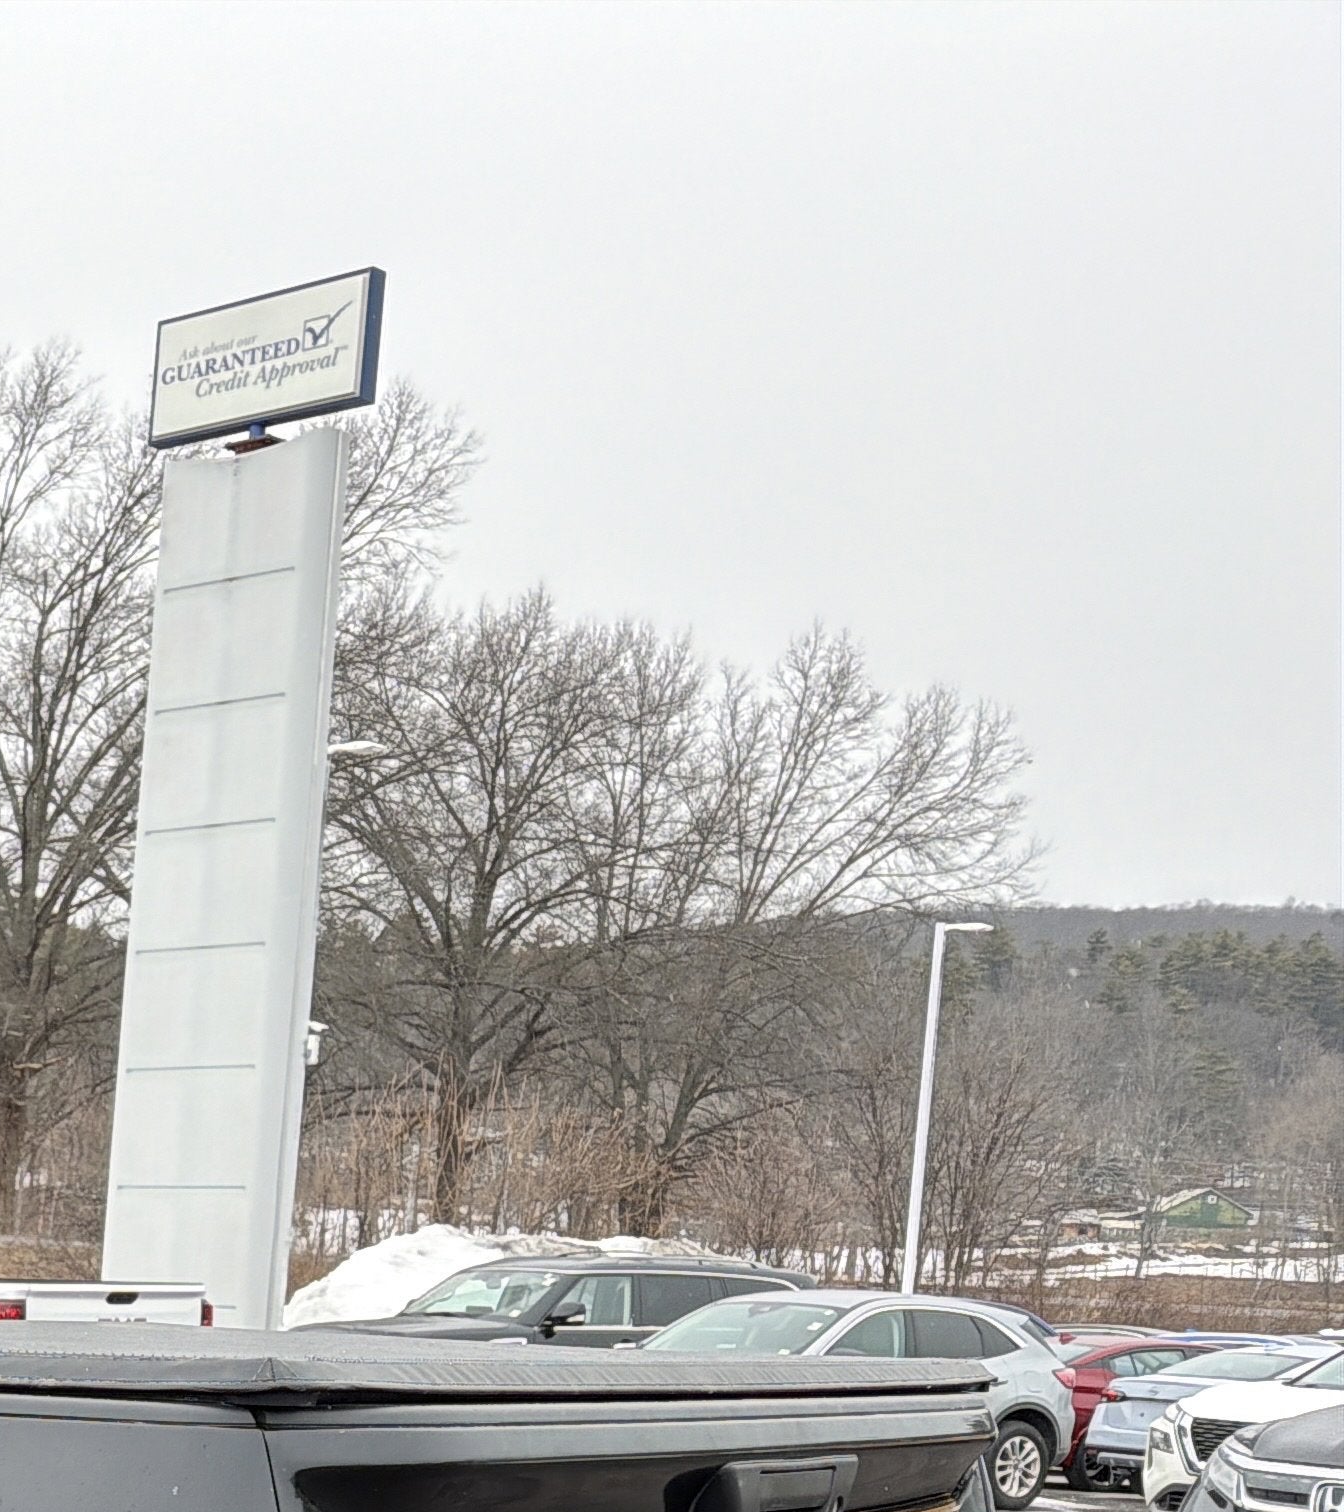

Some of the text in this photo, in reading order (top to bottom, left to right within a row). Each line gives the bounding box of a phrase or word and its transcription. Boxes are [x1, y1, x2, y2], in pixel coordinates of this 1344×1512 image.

[161, 337, 300, 386] GUARANTEED
[178, 346, 199, 362] Ask
[195, 346, 340, 398] Credit Approval
